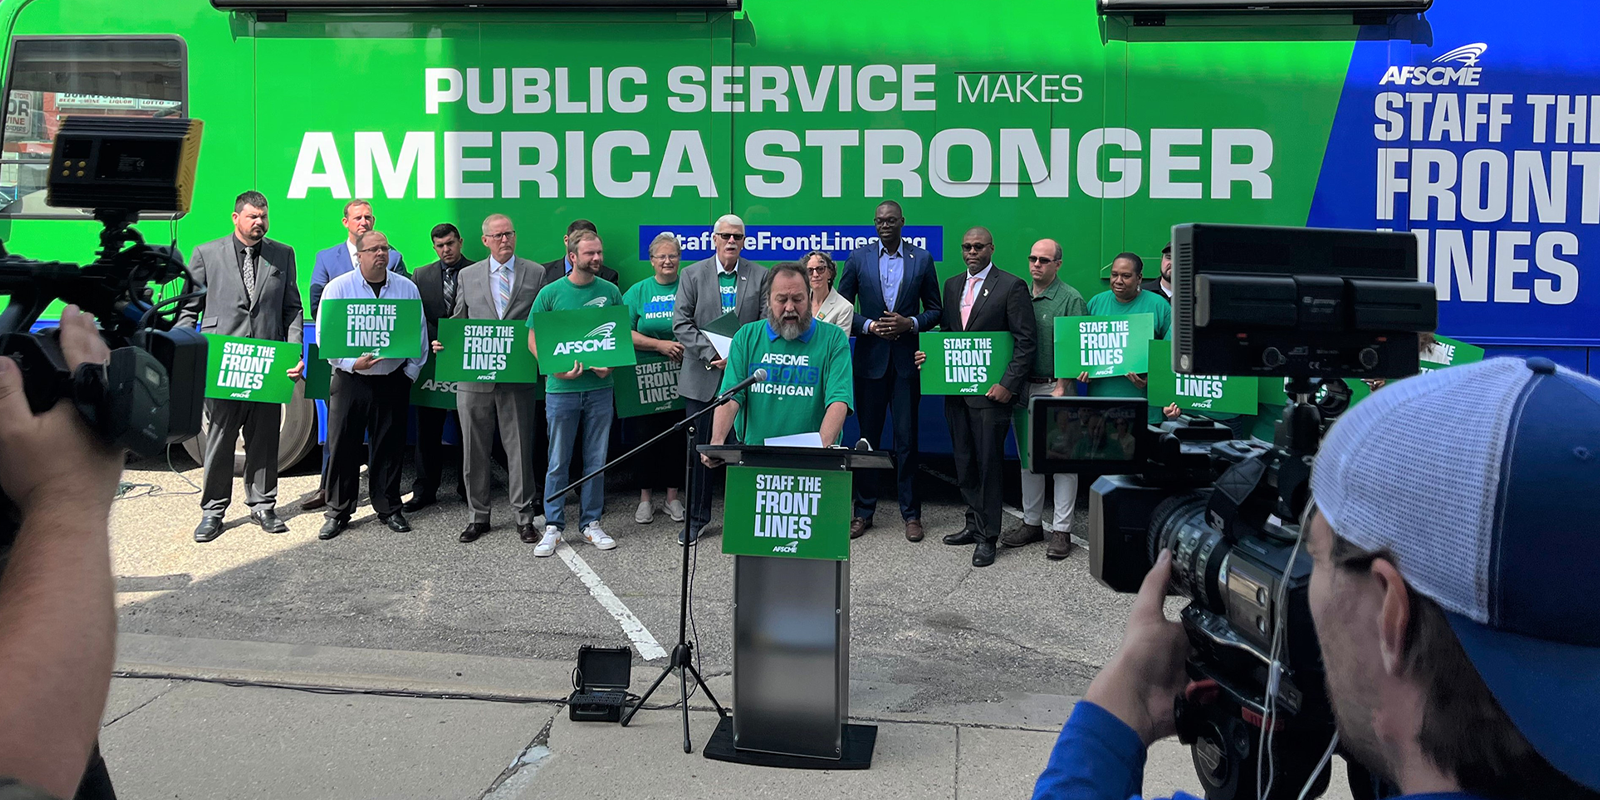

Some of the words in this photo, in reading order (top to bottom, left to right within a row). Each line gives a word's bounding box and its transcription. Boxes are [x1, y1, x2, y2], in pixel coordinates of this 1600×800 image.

[1378, 65, 1483, 86] AFSCME
[424, 66, 648, 114] PUBLIC
[667, 64, 937, 113] SERVICE
[957, 74, 1084, 103] MAKES
[1373, 91, 1514, 142] STAFF
[286, 130, 719, 199] AMERICA
[744, 127, 1274, 199] STRONGER
[1376, 147, 1600, 225] FRONT
[347, 303, 377, 315] STAFF
[378, 303, 397, 316] THE
[347, 315, 397, 331] FRONT
[463, 325, 494, 337] STAFF
[496, 325, 514, 337] THE
[1079, 321, 1109, 333] STAFF
[1110, 320, 1129, 332] THE
[346, 331, 391, 348] LINES
[463, 337, 514, 354] FRONT
[553, 337, 616, 356] AFSCME
[943, 338, 972, 350] STAFF
[973, 337, 992, 350] THE
[1080, 332, 1129, 349] FRONT
[223, 341, 256, 356] STAFF
[256, 345, 276, 358] THE
[944, 349, 992, 366] FRONT
[1080, 349, 1124, 366] LINES
[220, 353, 275, 374] FRONT
[462, 353, 507, 370] LINES
[635, 361, 663, 375] STAFF
[664, 360, 681, 371] THE
[760, 352, 810, 367] AFSCME
[216, 370, 265, 390] LINES
[637, 370, 681, 390] FRONT
[945, 366, 987, 383] LINES
[420, 379, 458, 393] AFSC
[751, 382, 814, 397] MICHIGAN
[1175, 378, 1223, 399] LINES
[639, 385, 680, 405] LINES
[756, 474, 795, 491] STAFF
[797, 476, 822, 493] THE
[755, 491, 822, 516] FRONT
[754, 514, 812, 540] LINES
